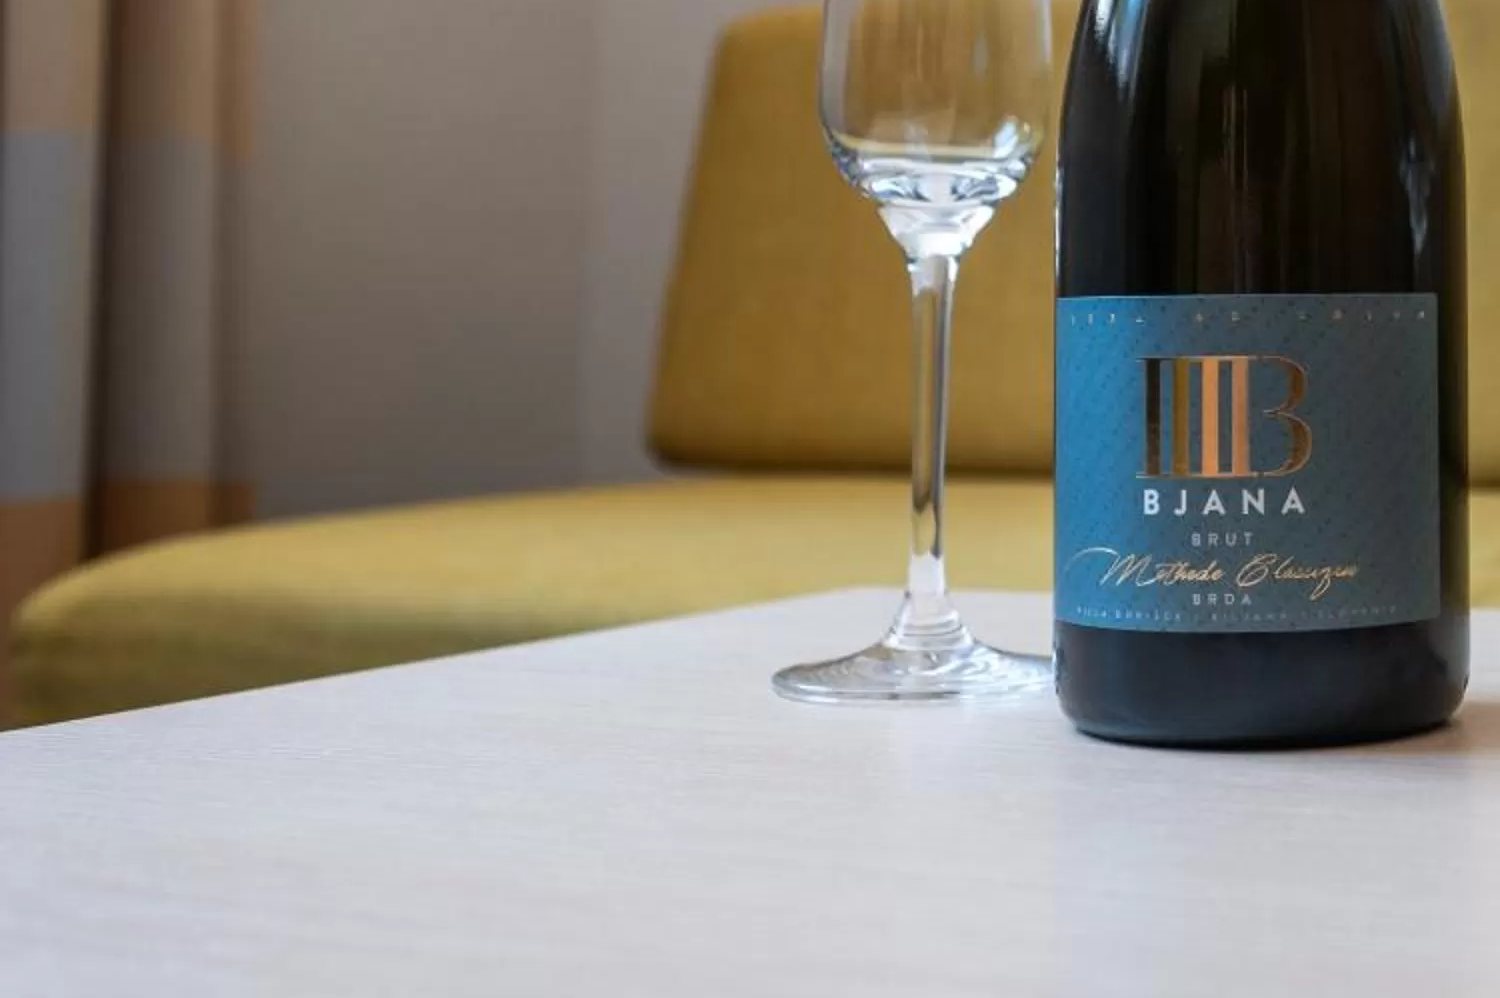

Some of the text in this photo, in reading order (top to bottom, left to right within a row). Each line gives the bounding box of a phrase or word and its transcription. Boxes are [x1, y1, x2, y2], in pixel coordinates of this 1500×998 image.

[1143, 486, 1306, 516] BJANA
[1191, 532, 1255, 547] BRUT
[1193, 593, 1253, 606] BRDA
